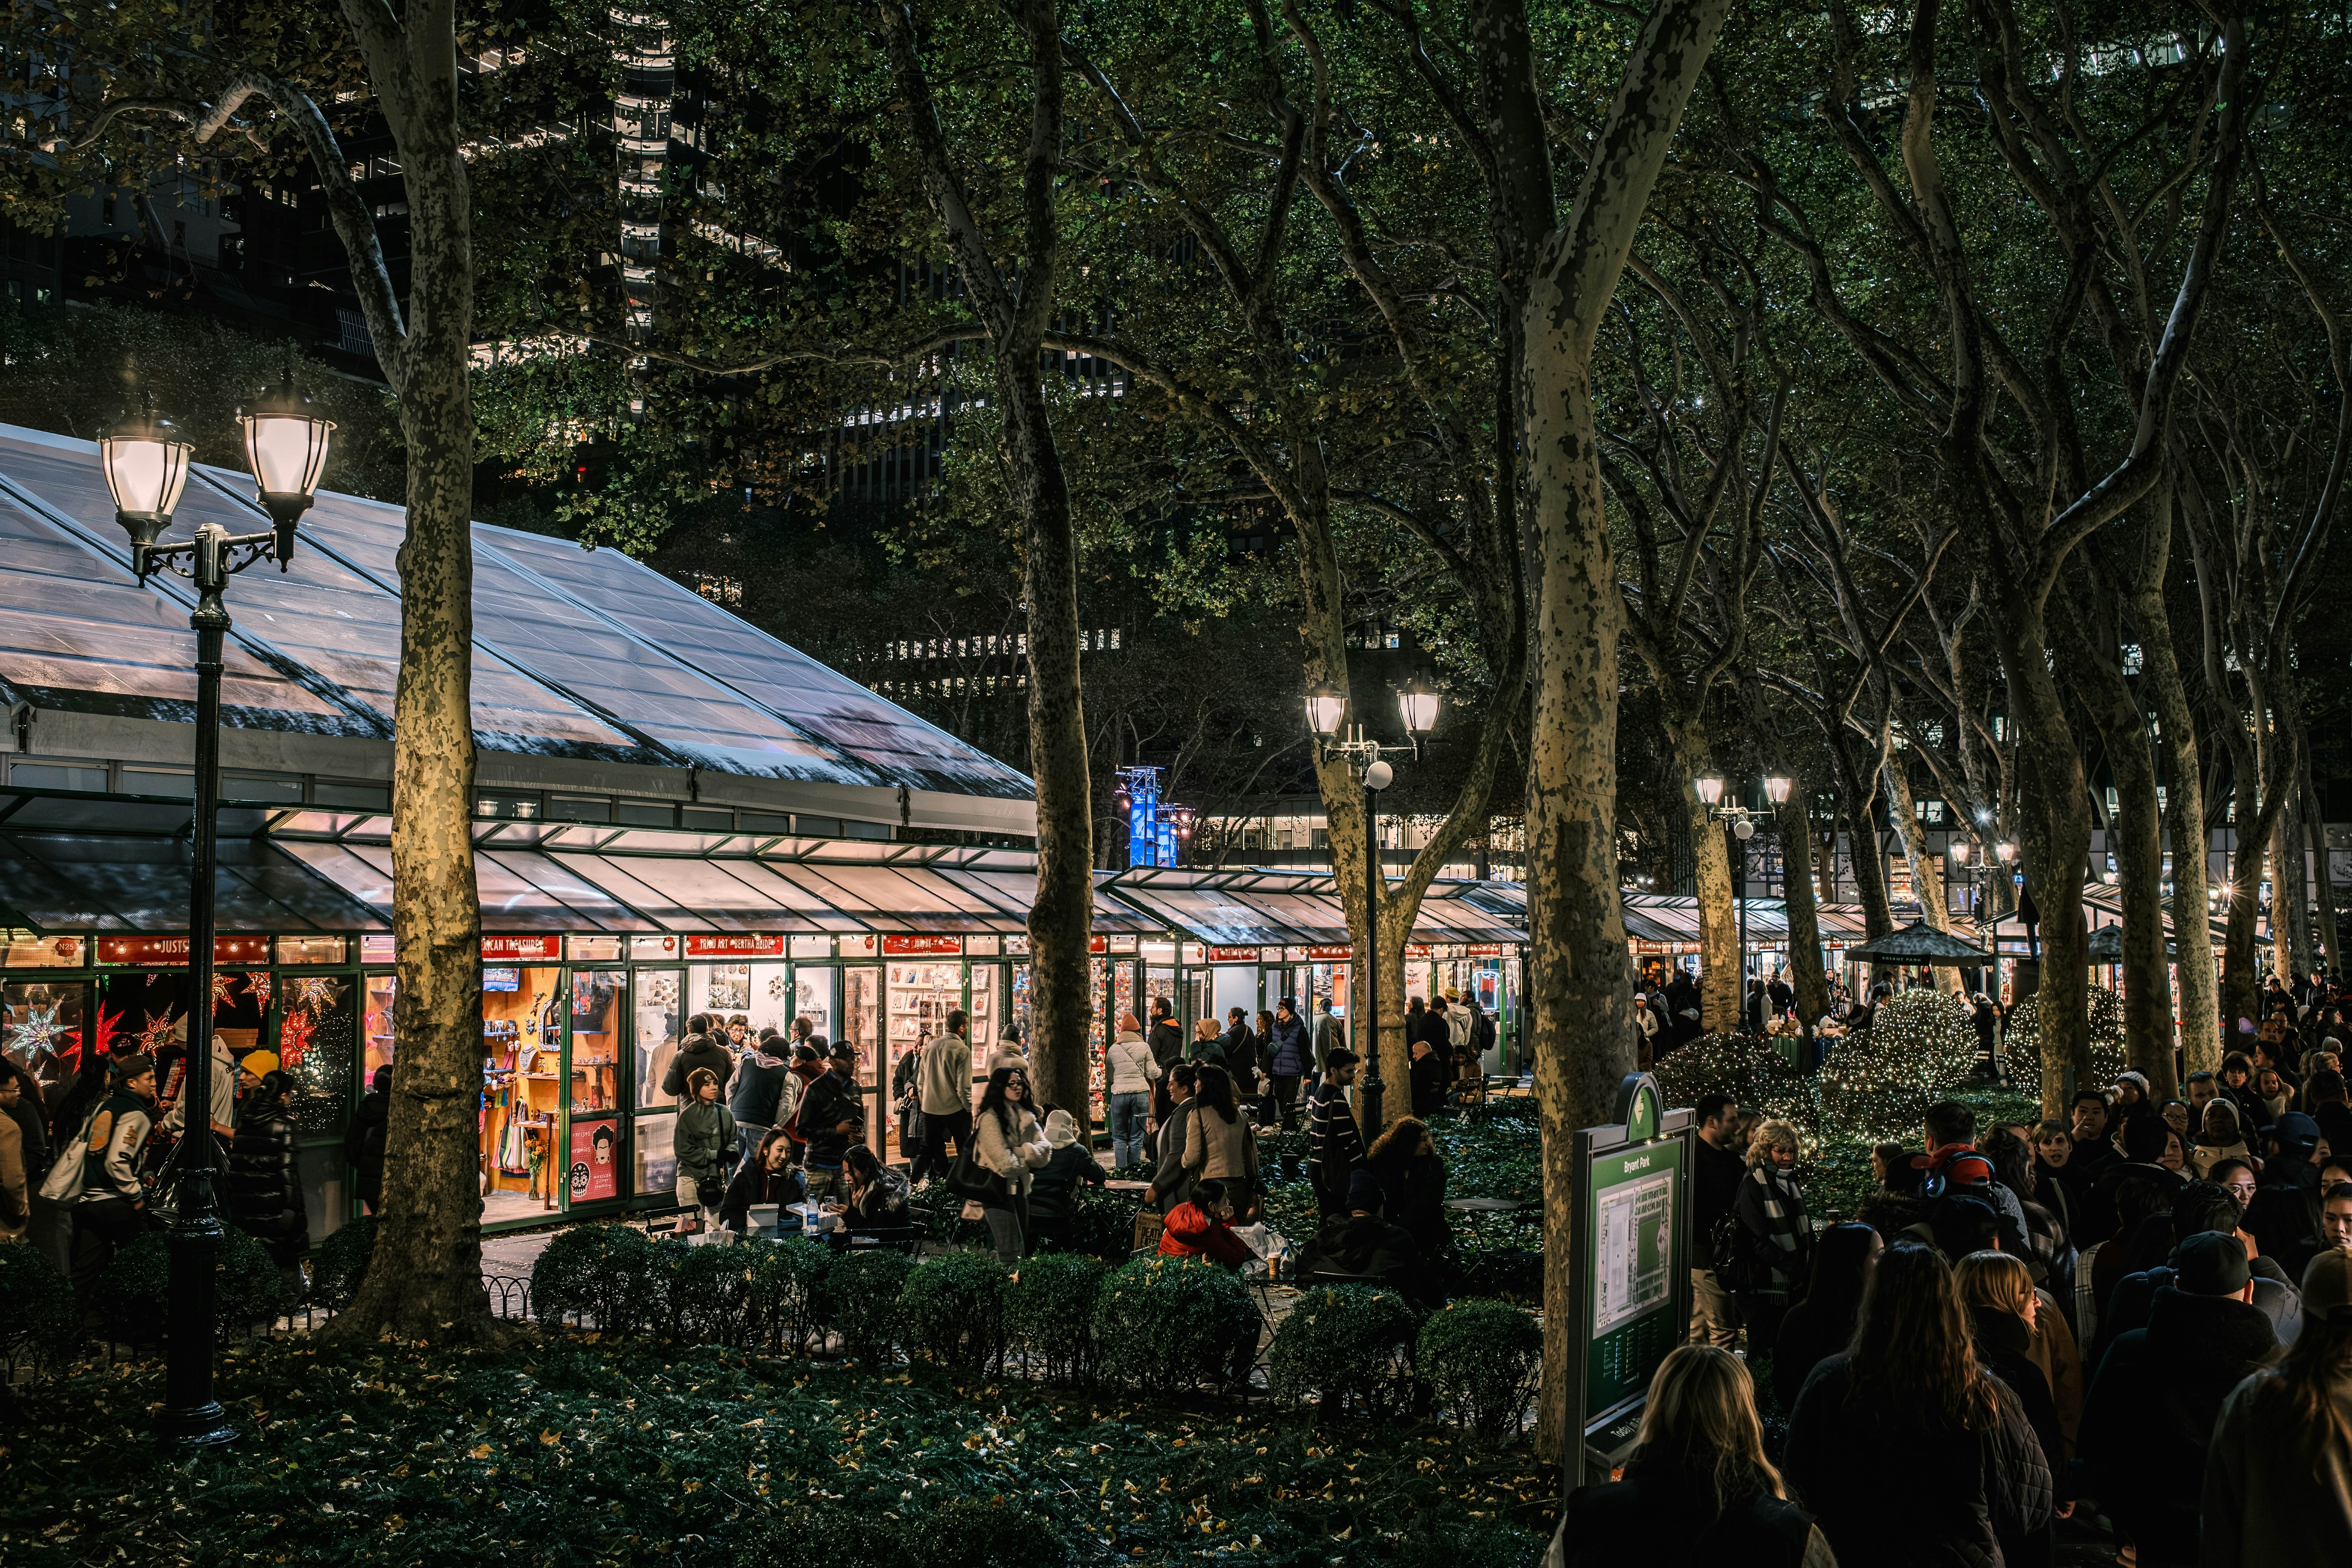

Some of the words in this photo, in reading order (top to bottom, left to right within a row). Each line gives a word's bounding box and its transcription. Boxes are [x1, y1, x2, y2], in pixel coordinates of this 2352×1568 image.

[717, 939, 728, 949] ART
[734, 939, 755, 949] BERTHA
[1624, 1158, 1639, 1174] Bryant
[1640, 1155, 1650, 1169] Park
